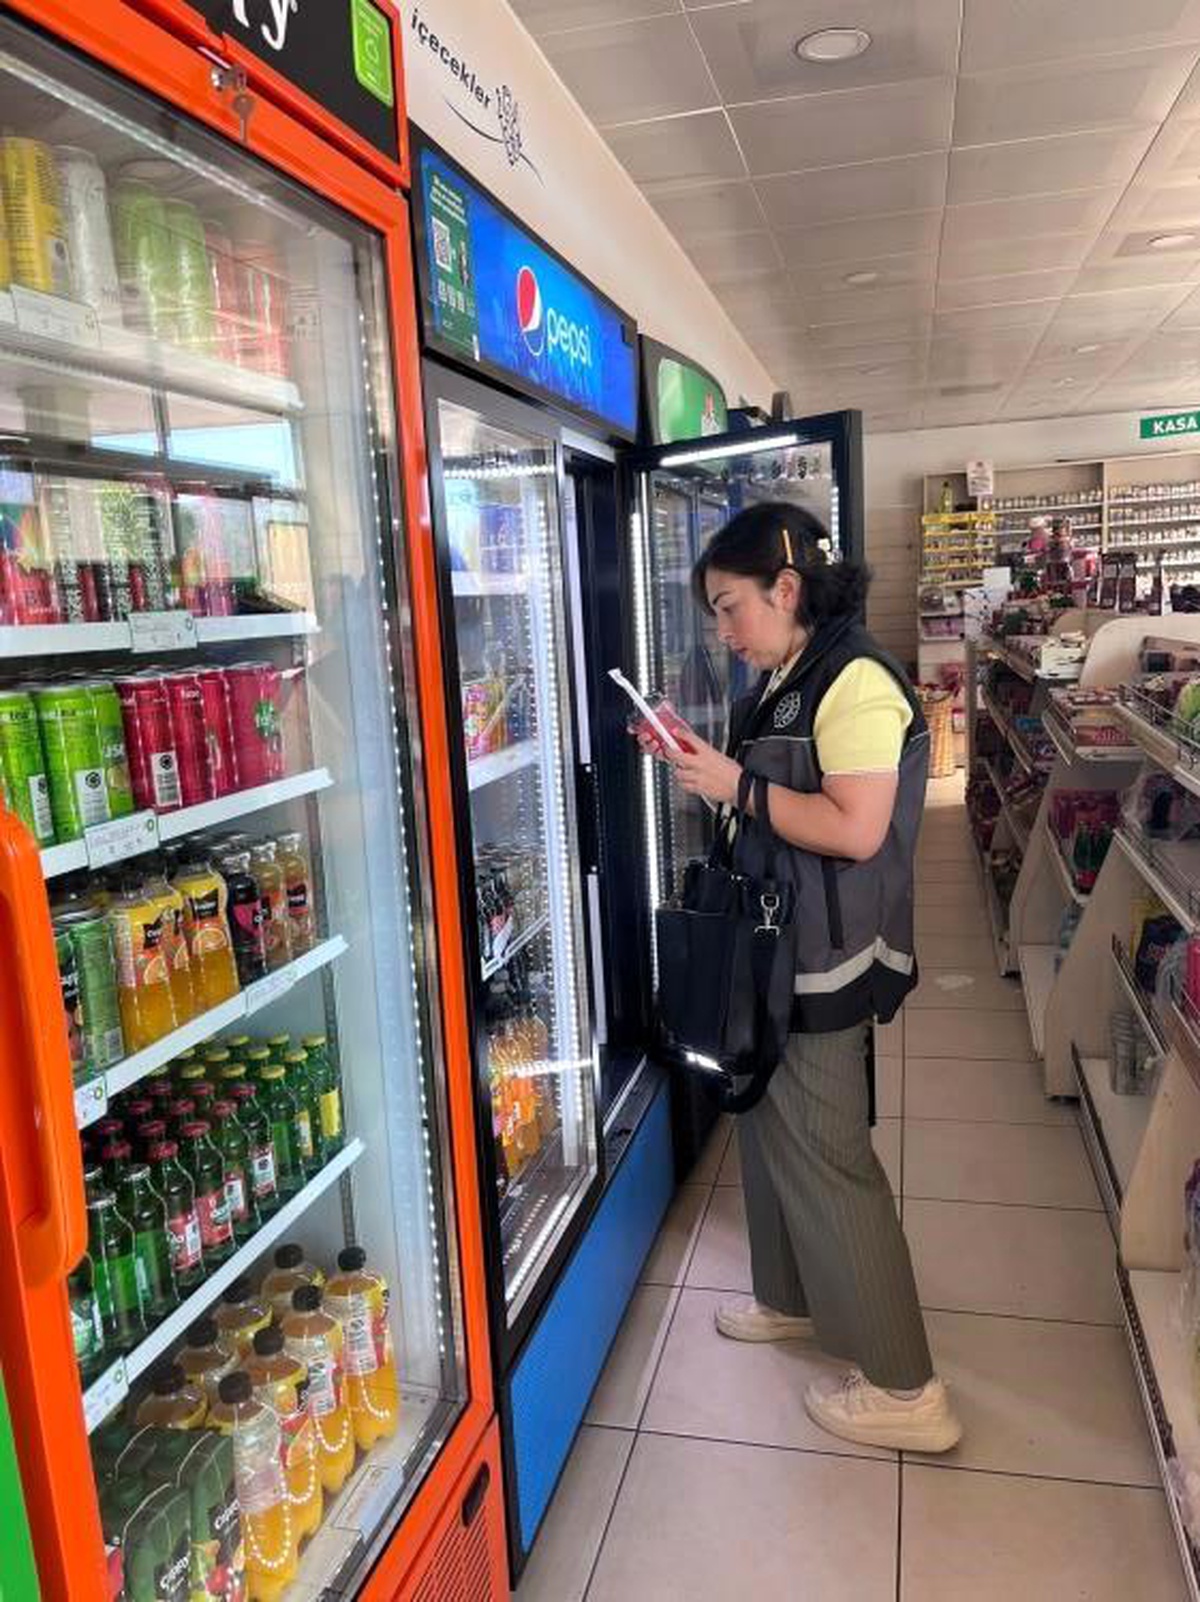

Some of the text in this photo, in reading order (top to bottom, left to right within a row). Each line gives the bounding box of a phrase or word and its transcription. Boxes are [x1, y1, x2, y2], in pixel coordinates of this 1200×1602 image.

[411, 8, 491, 109] içecekler
[547, 307, 592, 369] pepsi
[1153, 416, 1198, 434] KASA
